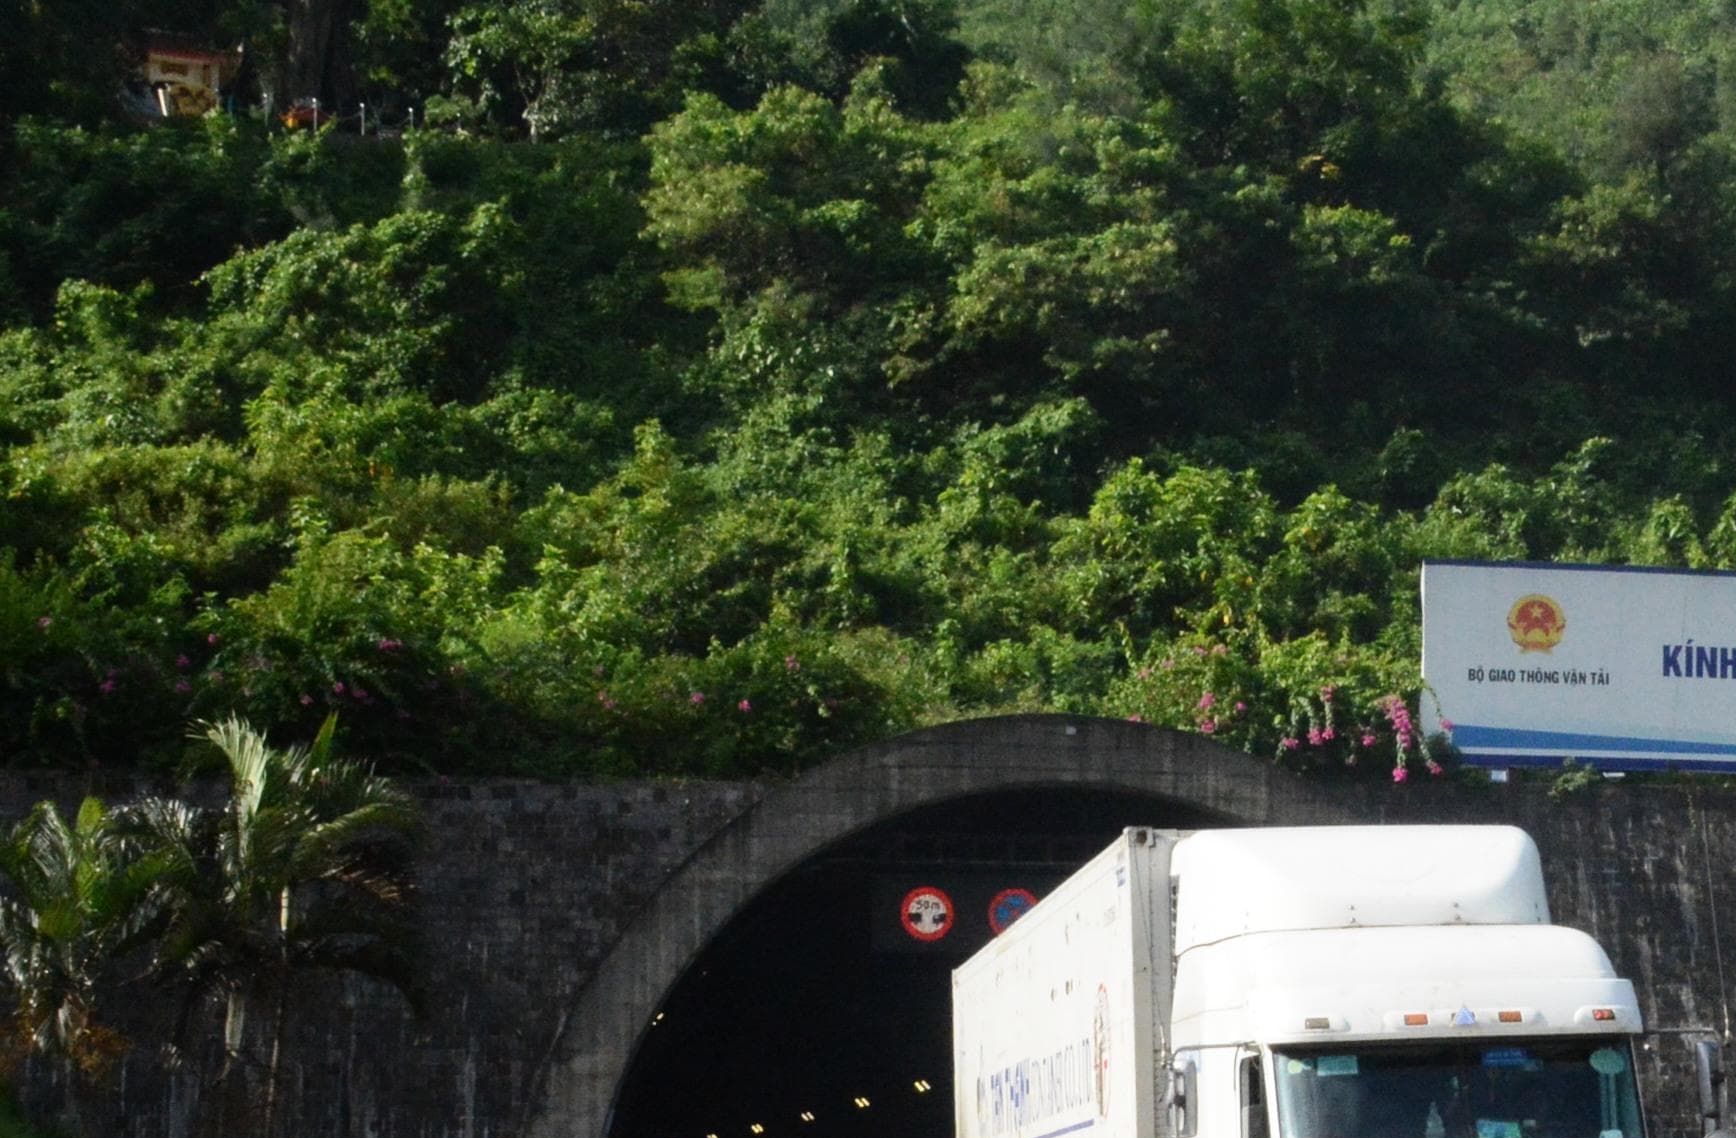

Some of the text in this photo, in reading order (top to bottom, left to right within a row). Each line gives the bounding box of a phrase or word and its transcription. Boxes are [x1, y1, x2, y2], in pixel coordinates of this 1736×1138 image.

[1468, 666, 1609, 687] BỘ GIAO THÔNG VẬN TẢI
